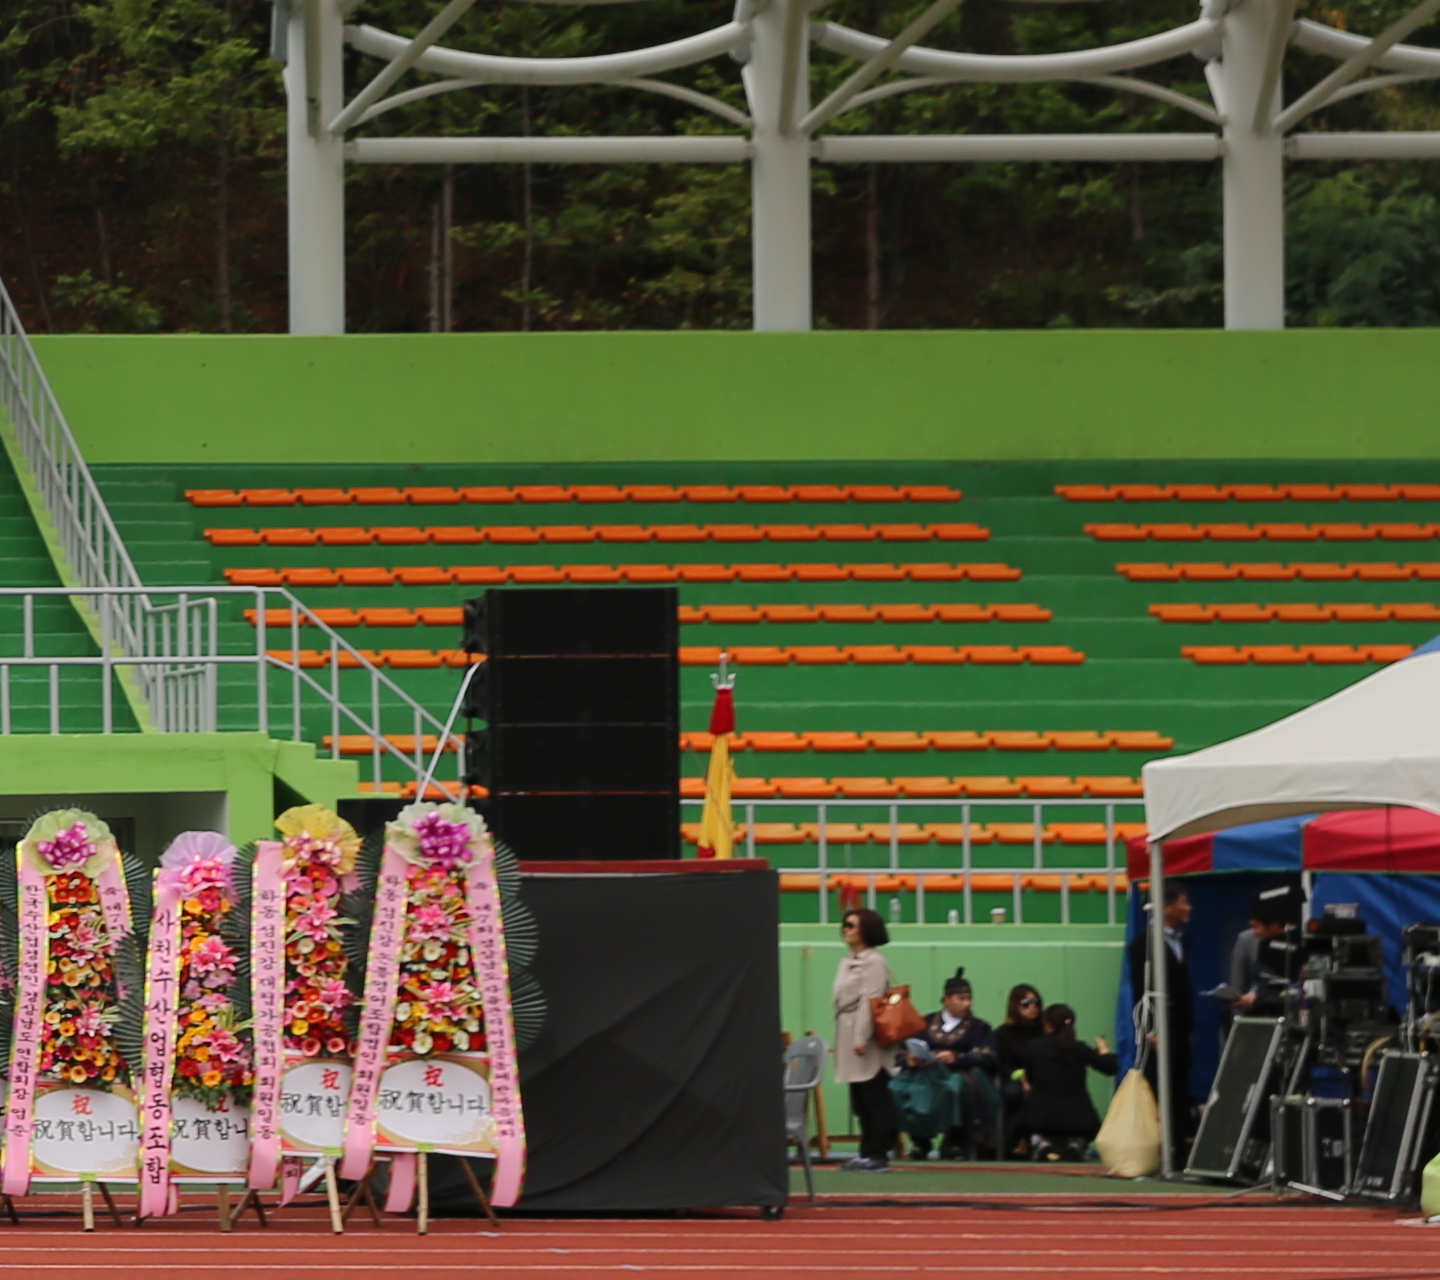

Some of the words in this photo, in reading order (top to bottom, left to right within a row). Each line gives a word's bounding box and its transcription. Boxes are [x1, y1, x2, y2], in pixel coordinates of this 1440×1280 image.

[144, 908, 176, 1185] 사천수산업협동조합
[321, 1067, 341, 1090] 祝
[422, 1064, 444, 1088] 祝
[71, 1094, 93, 1116] 祝
